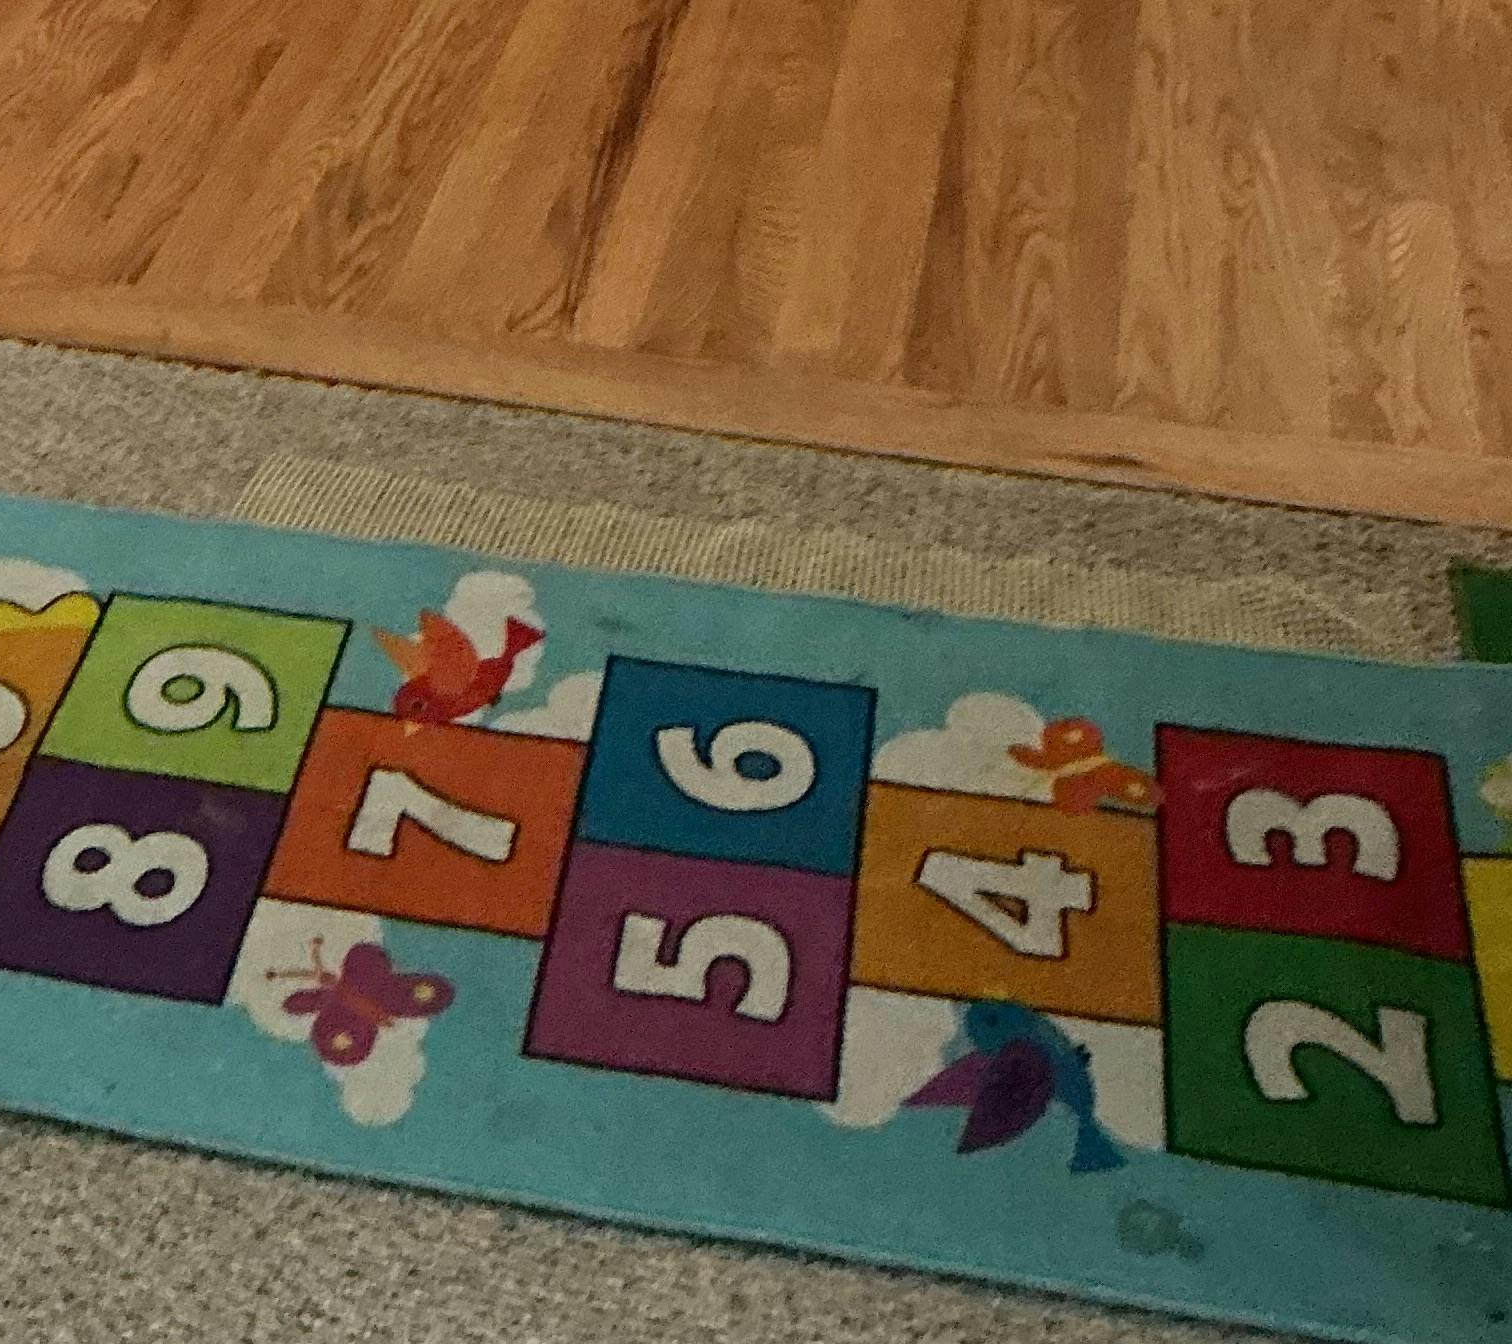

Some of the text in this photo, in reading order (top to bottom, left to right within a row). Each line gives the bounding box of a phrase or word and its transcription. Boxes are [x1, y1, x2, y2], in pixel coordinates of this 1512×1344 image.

[125, 644, 278, 734] 9
[656, 720, 815, 811] 6
[347, 768, 519, 863] 7
[1224, 790, 1401, 881] 3
[42, 823, 209, 926] 8
[915, 849, 1097, 958] 4
[613, 913, 792, 1022] 5
[1244, 1001, 1439, 1125] 2
